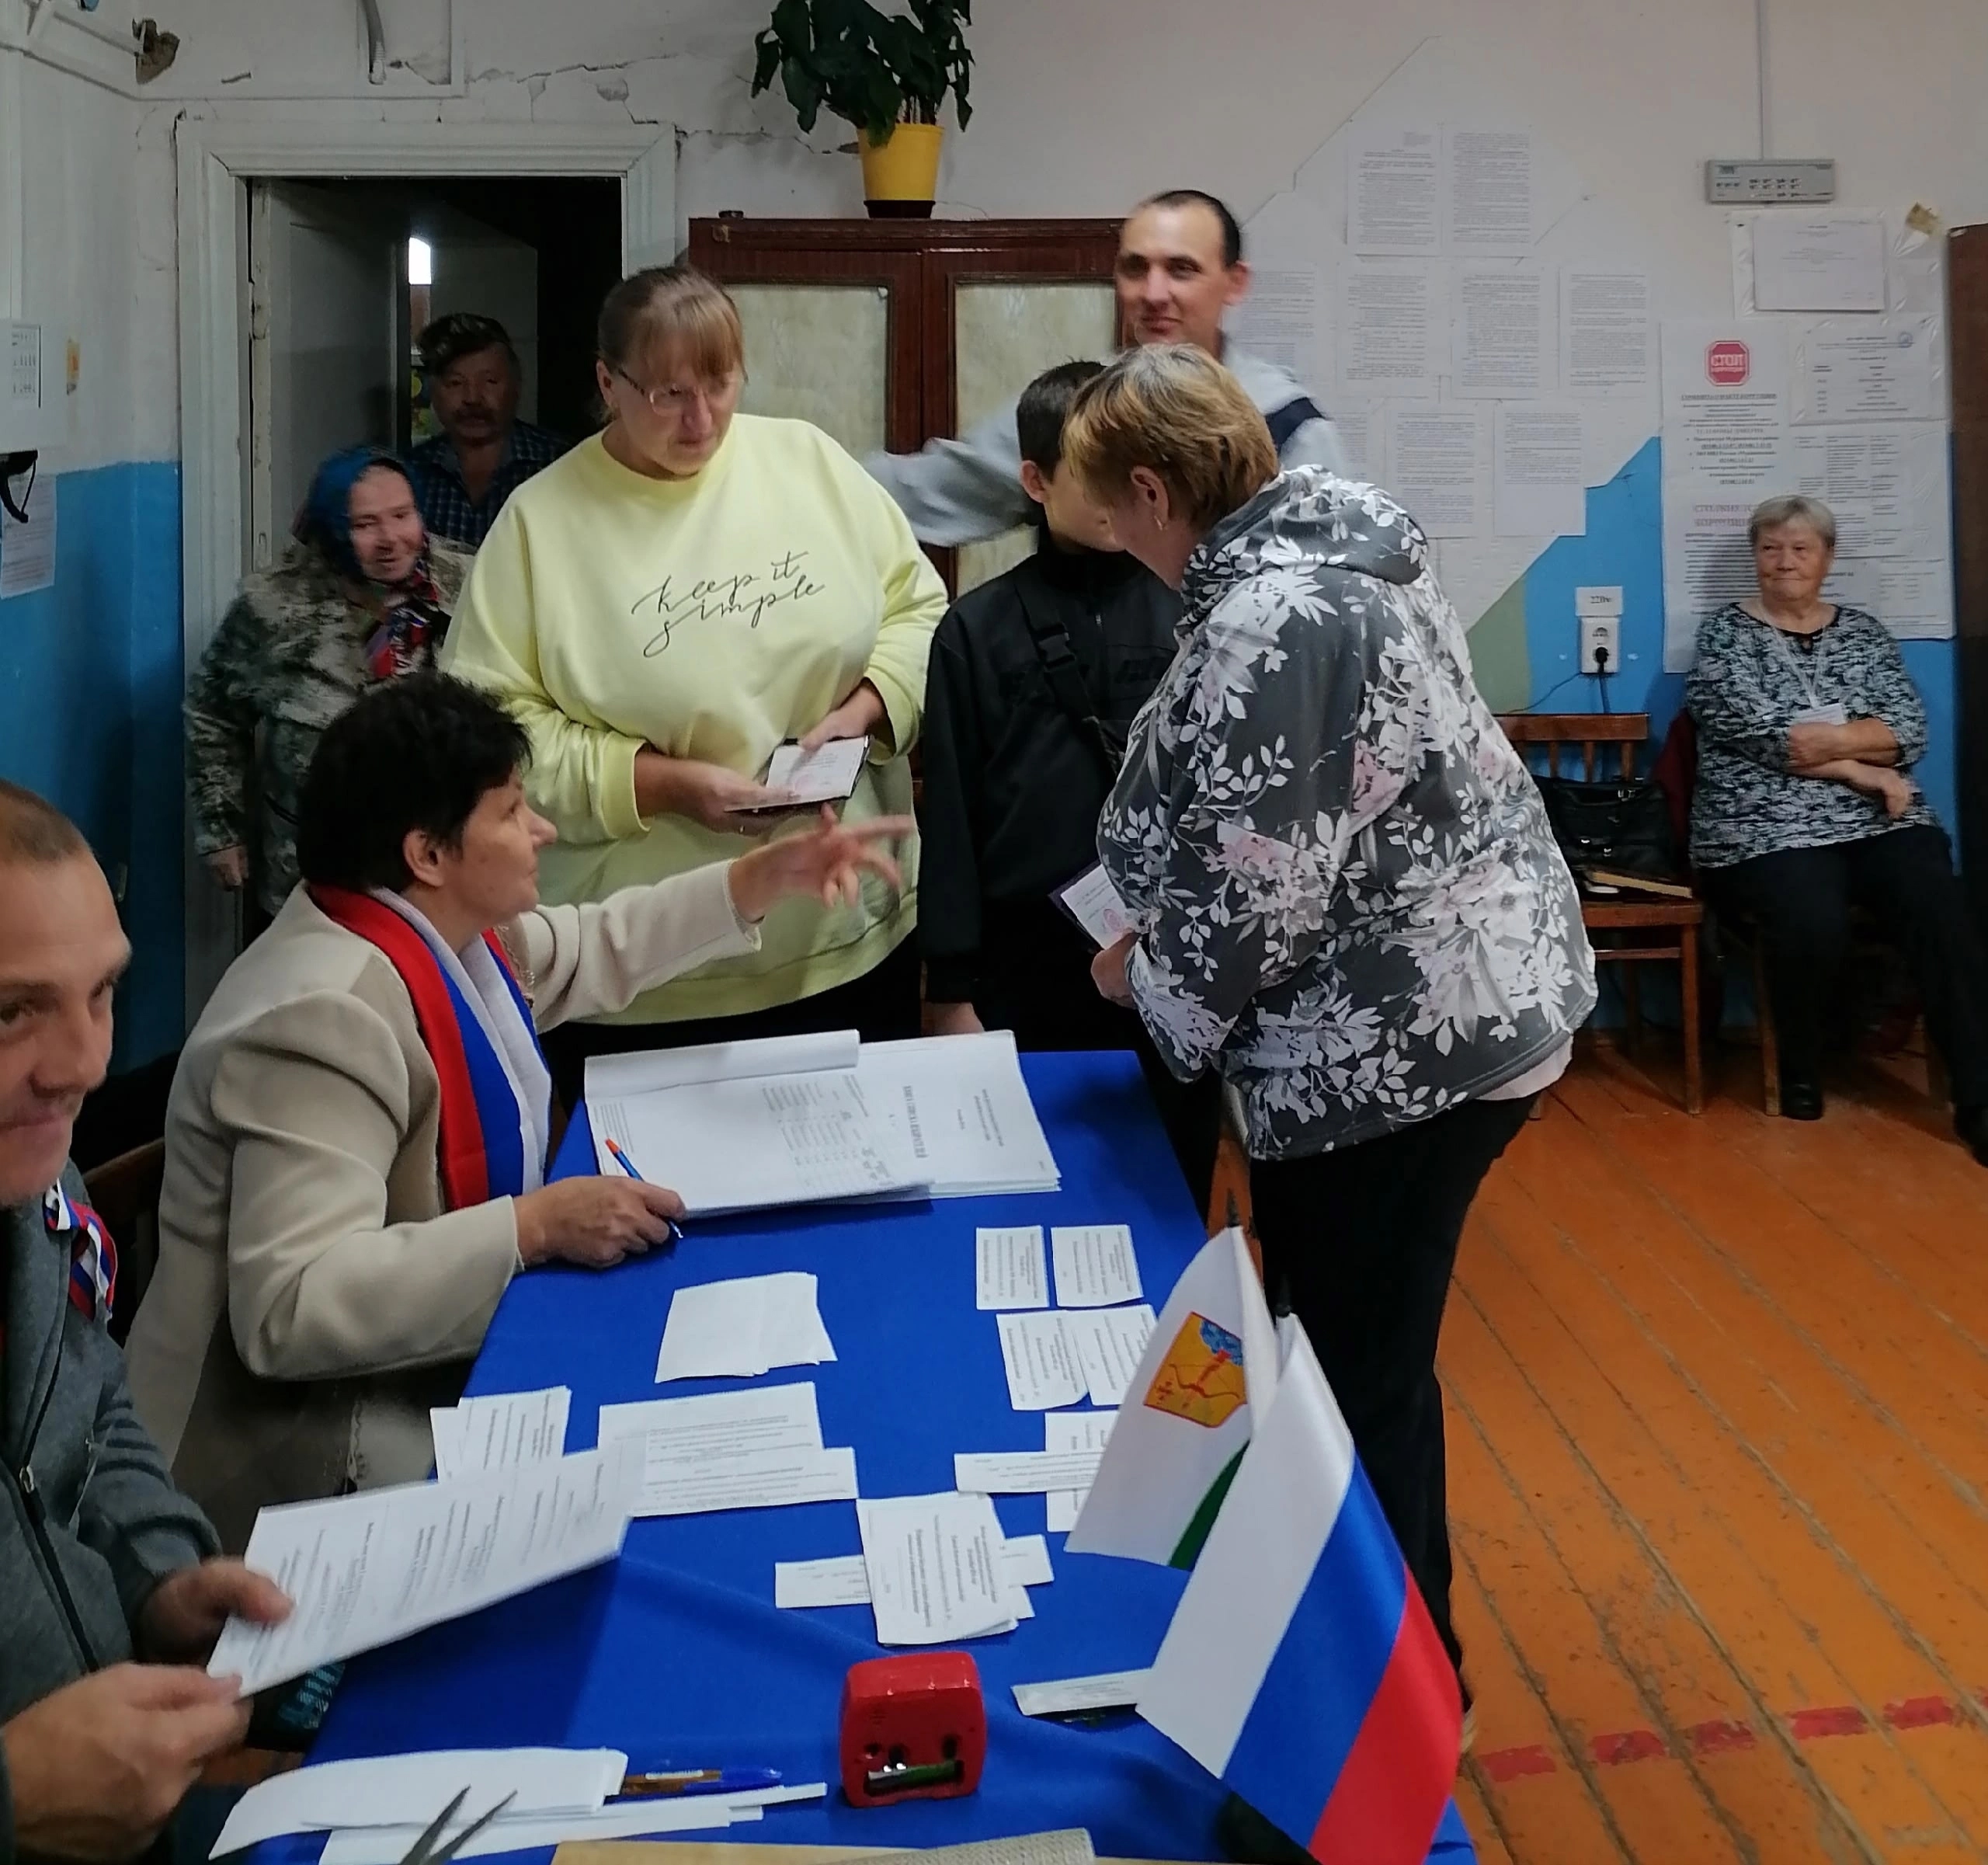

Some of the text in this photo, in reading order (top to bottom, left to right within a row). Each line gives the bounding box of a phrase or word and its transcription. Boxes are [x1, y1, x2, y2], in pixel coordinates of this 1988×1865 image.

[631, 551, 808, 614] keep it
[643, 575, 825, 658] simple
